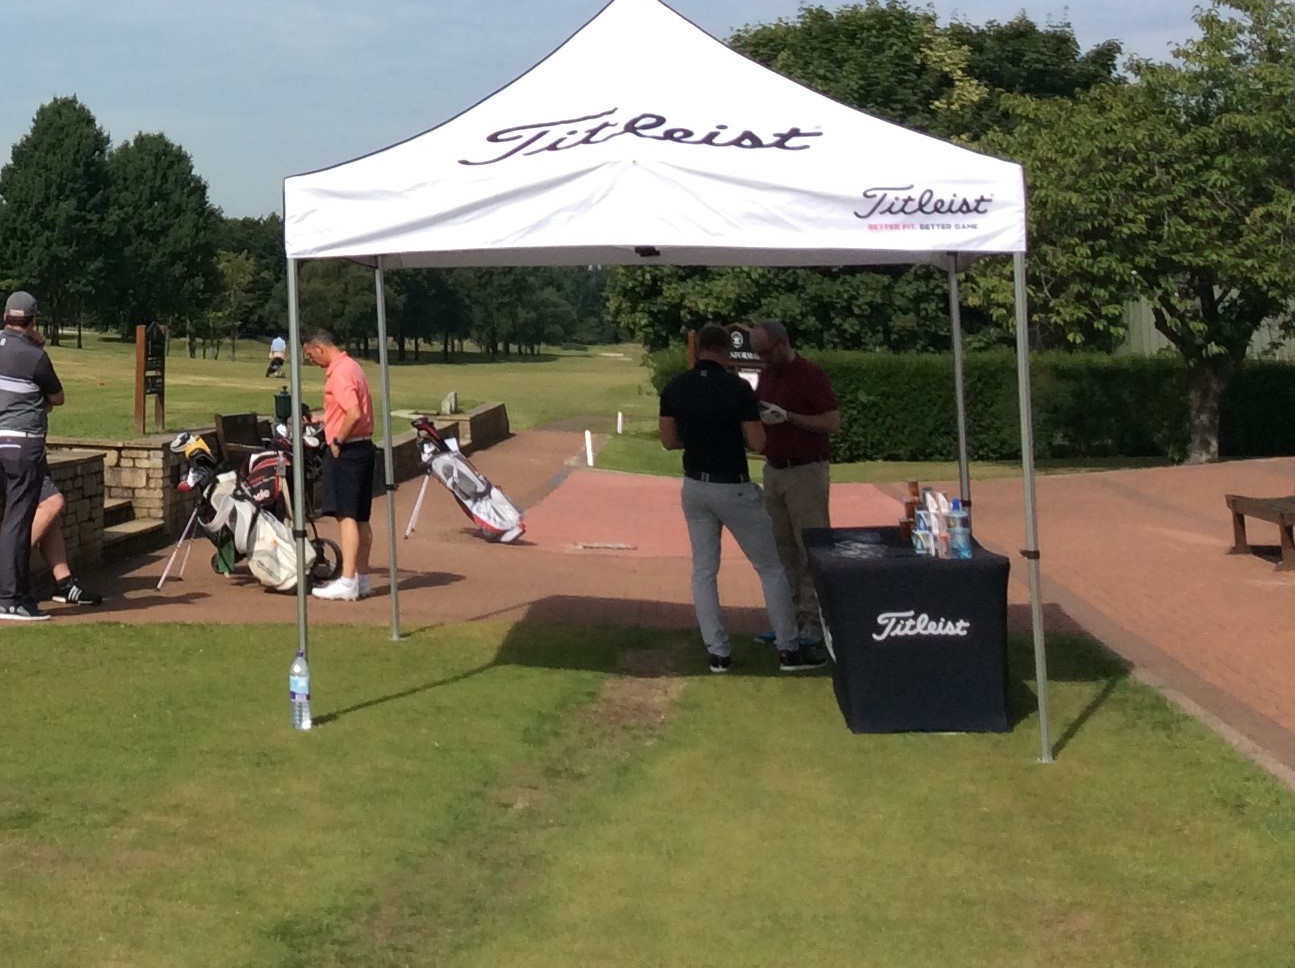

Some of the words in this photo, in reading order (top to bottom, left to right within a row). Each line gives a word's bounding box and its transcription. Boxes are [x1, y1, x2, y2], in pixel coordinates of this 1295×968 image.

[458, 107, 823, 166] Titleist
[854, 184, 993, 219] Titleist
[867, 223, 900, 231] BETTER
[919, 223, 952, 231] BETTER
[871, 610, 971, 641] Titleist
